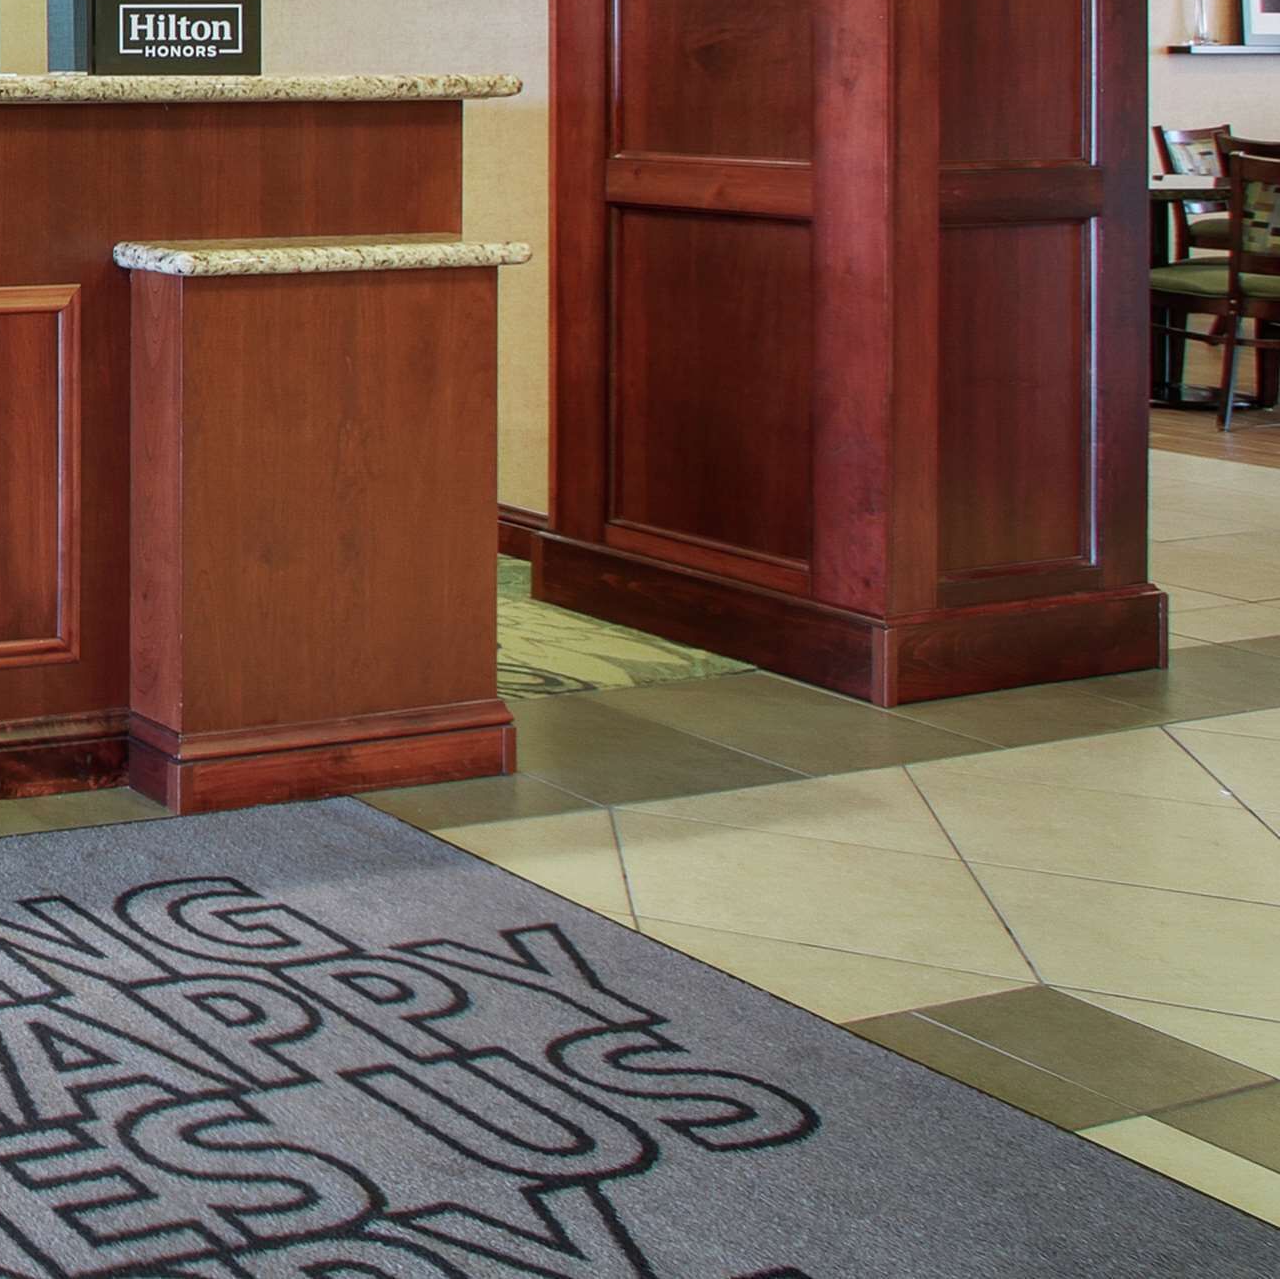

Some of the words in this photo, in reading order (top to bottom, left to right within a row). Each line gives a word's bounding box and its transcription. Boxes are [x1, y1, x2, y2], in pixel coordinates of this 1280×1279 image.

[129, 13, 233, 42] Hilton
[144, 45, 218, 58] HONORS
[339, 1022, 823, 1187] US
